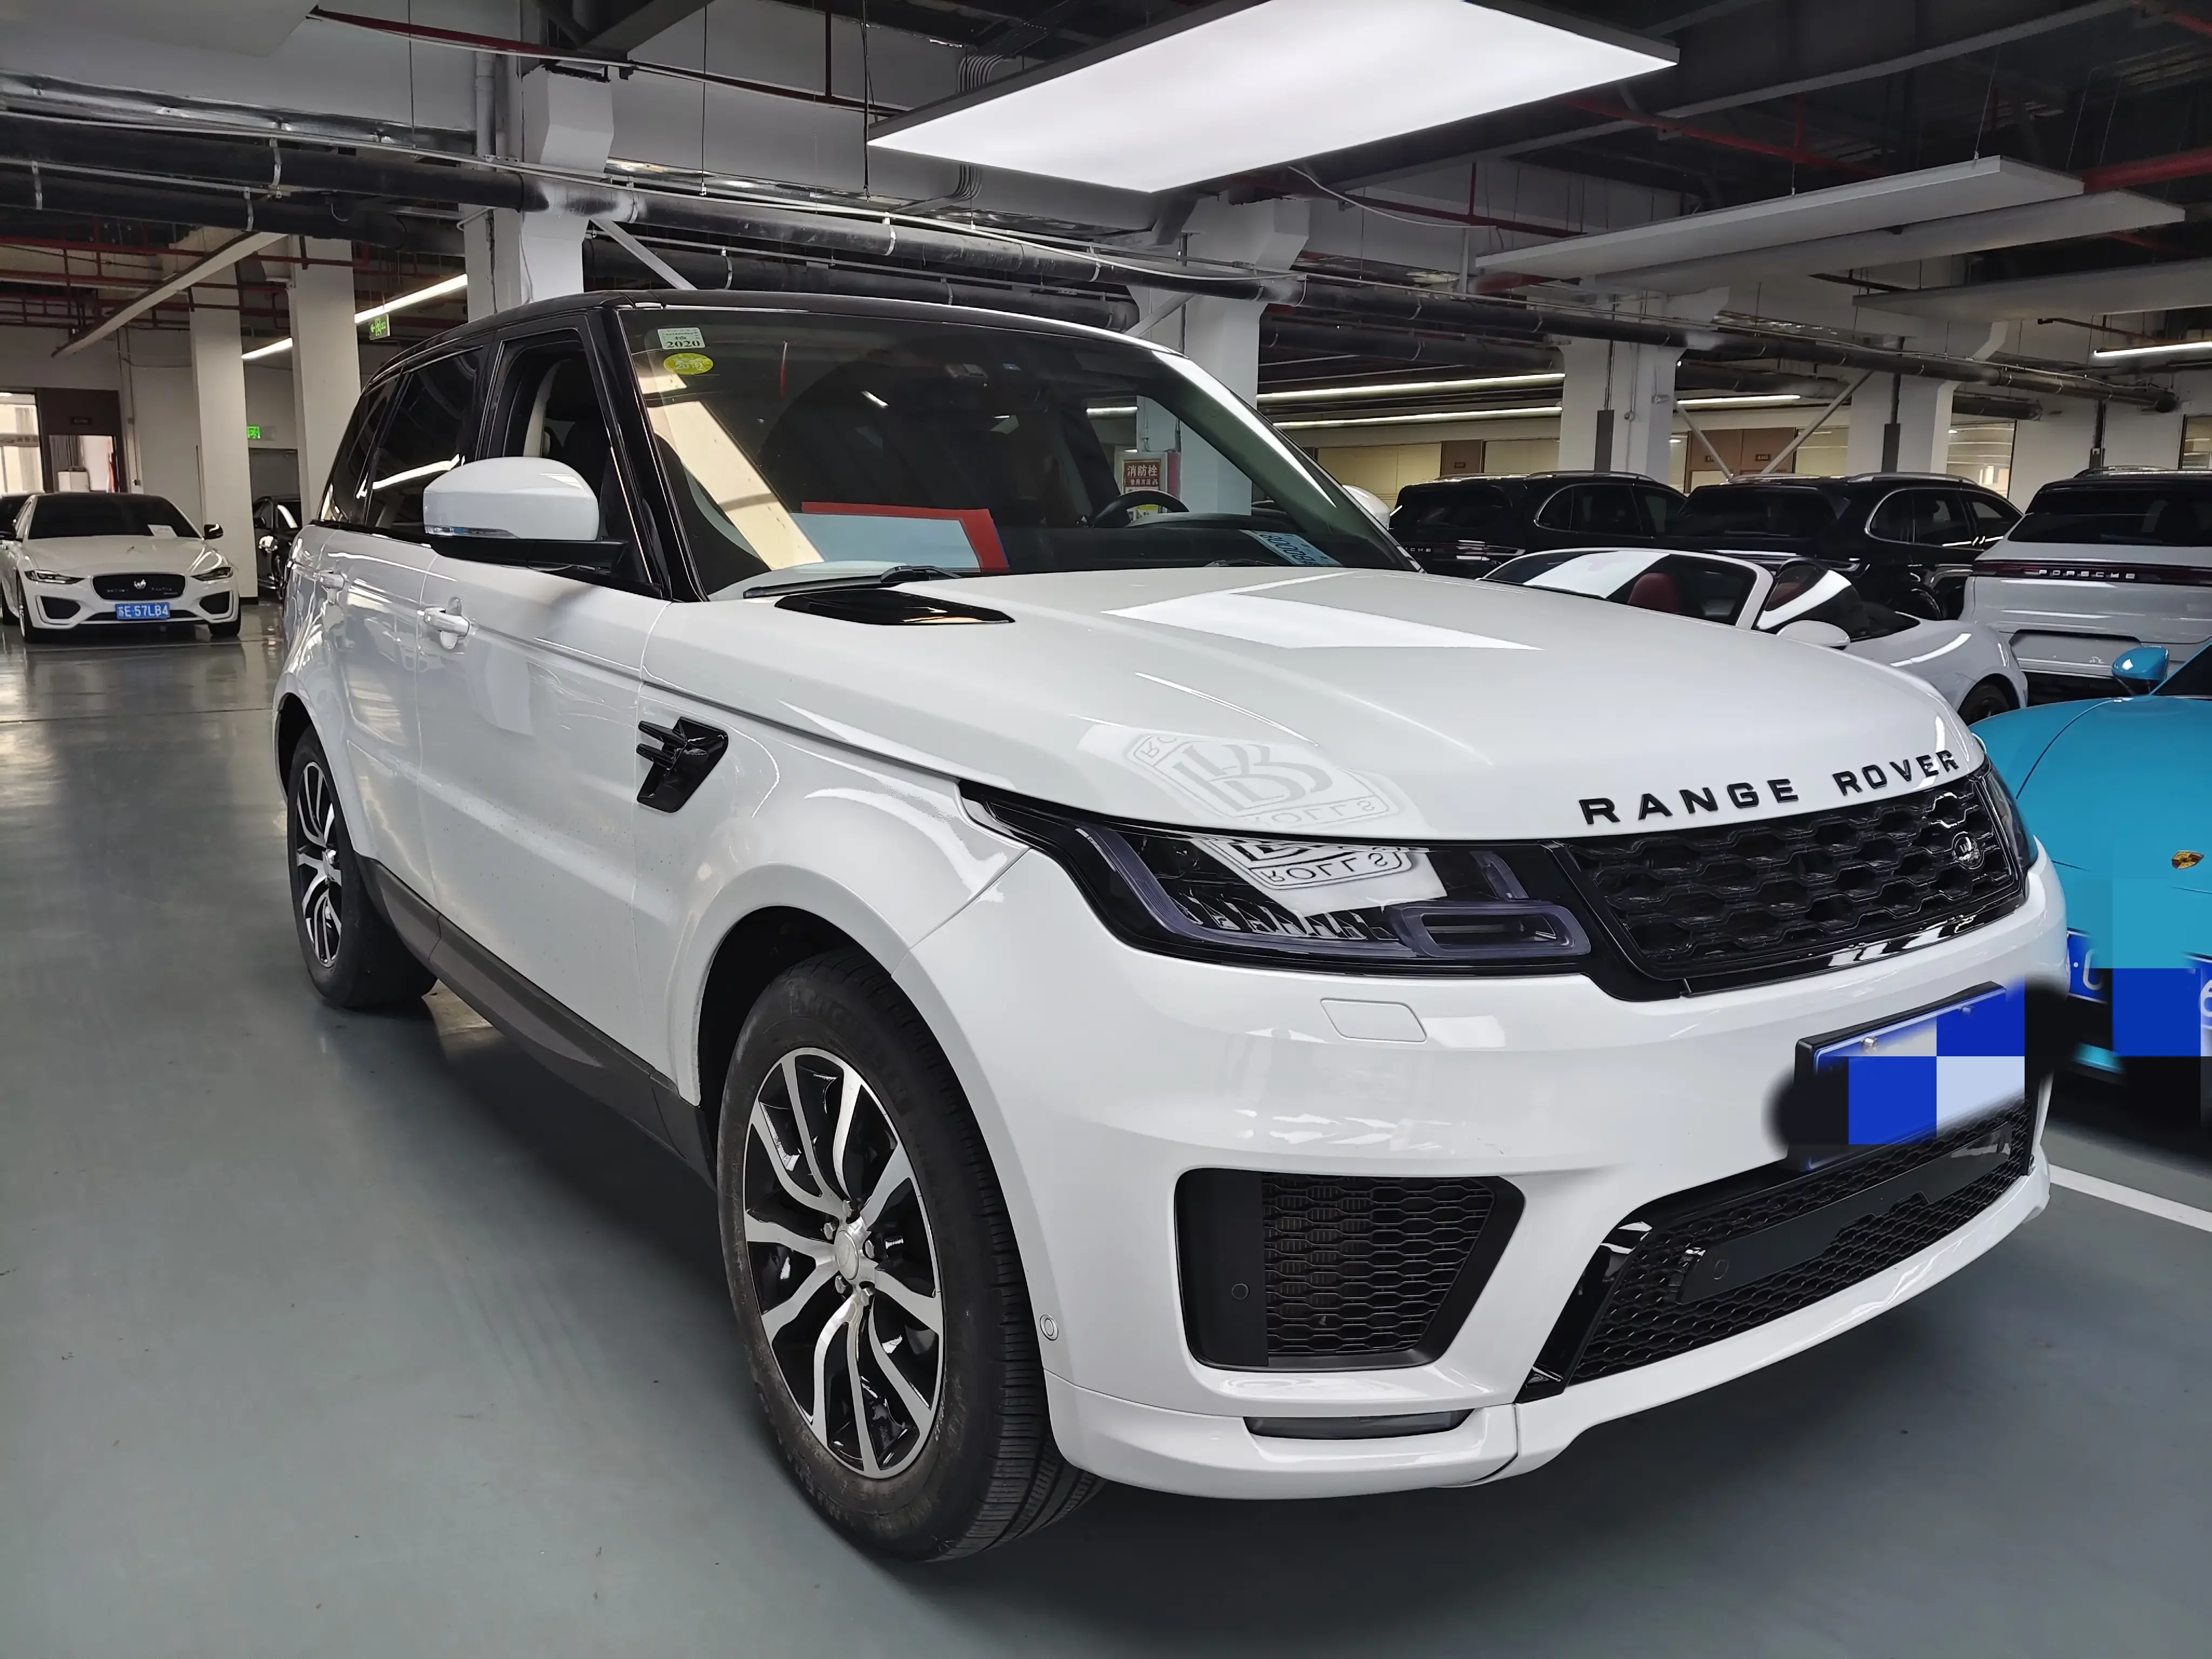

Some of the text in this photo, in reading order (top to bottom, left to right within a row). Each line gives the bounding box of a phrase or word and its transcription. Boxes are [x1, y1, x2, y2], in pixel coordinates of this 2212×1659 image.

[665, 340, 700, 348] 2020
[1127, 464, 1158, 476] 消防栓
[1579, 749, 1960, 825] RANGE ROVER
